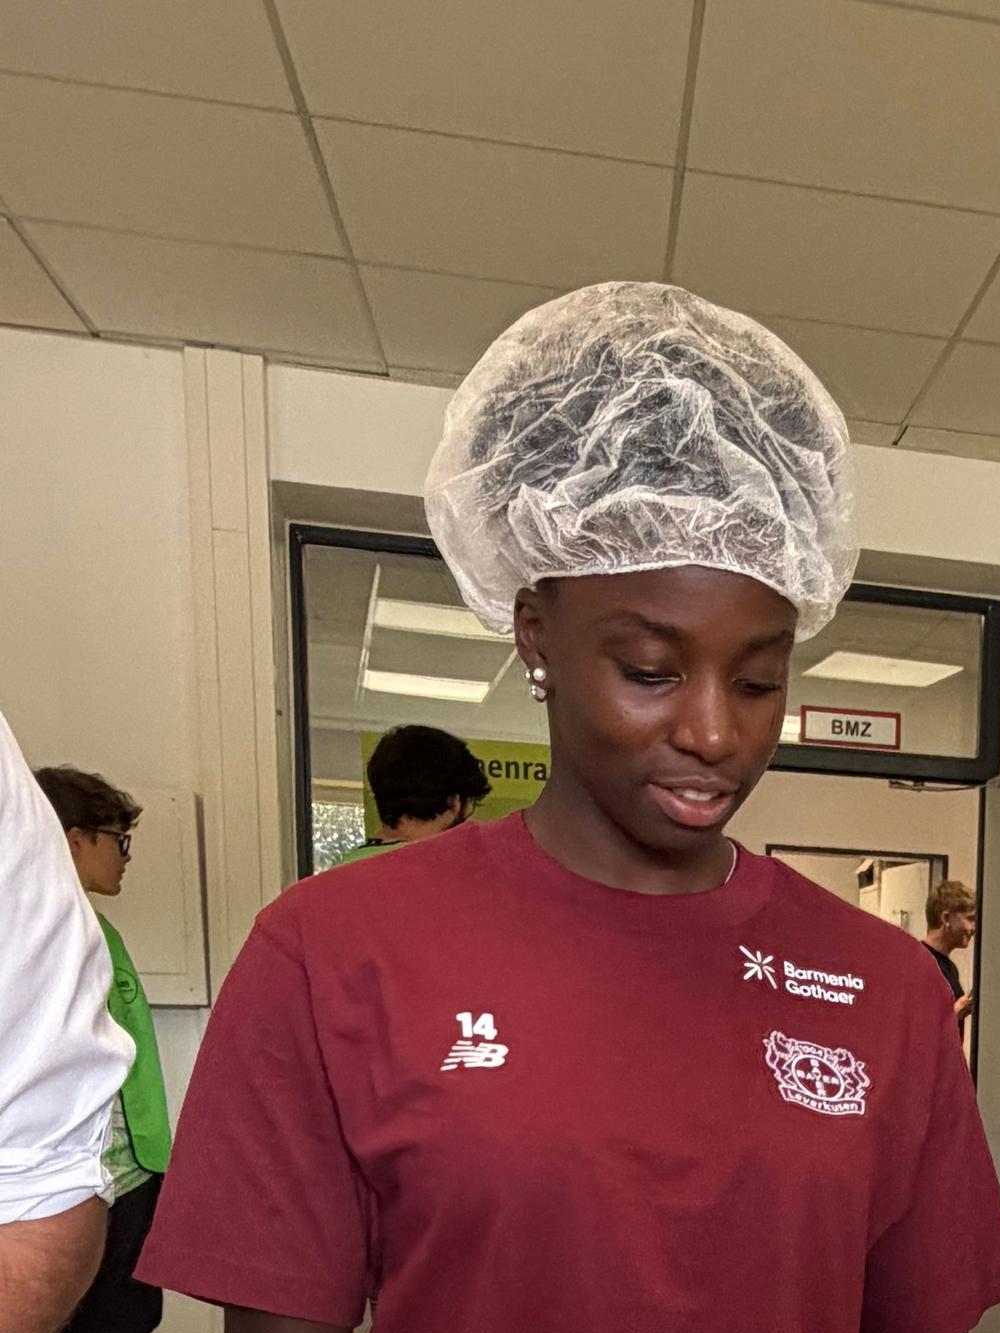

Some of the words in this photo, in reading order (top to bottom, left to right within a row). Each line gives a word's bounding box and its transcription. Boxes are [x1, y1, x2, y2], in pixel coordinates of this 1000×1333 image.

[831, 719, 872, 738] BMZ
[784, 960, 864, 990] Barmenia
[785, 979, 855, 1005] Gothaer
[456, 1011, 498, 1041] 14
[788, 1088, 860, 1113] Leverkusen
